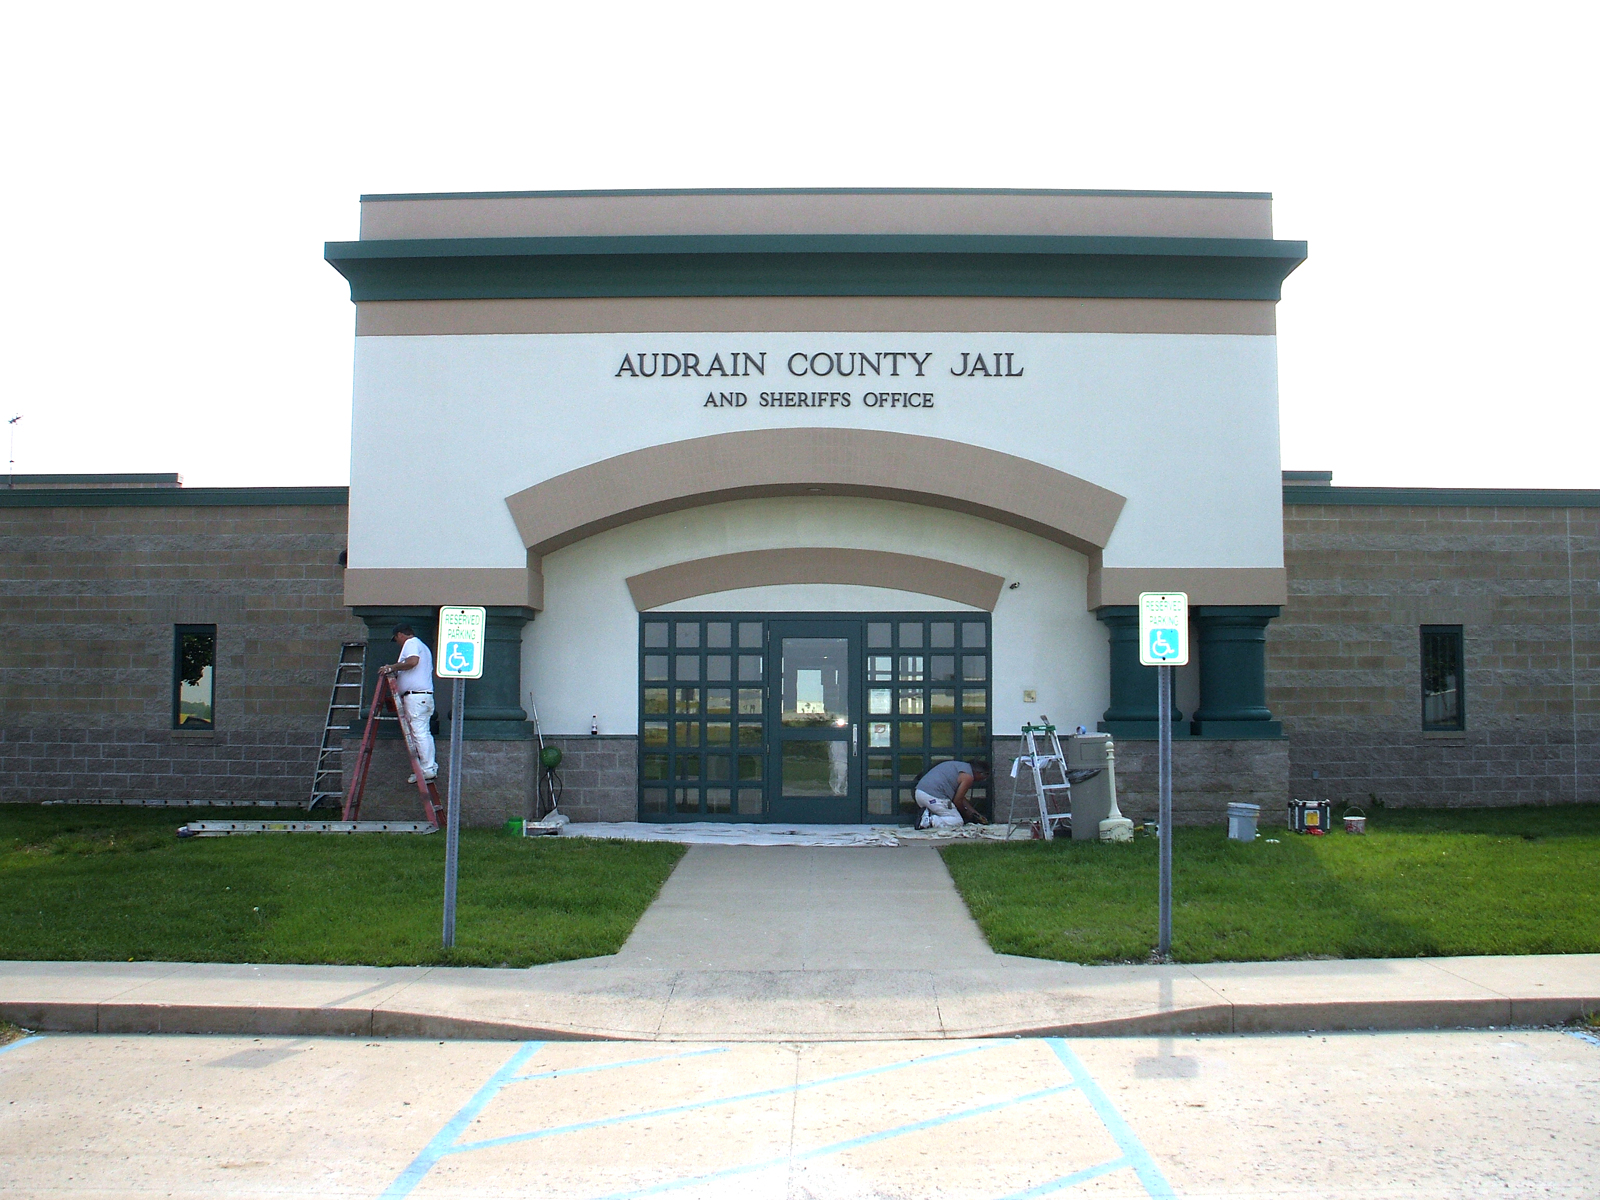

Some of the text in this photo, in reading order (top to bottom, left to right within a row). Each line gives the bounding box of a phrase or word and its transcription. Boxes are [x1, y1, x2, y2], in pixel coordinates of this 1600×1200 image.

[614, 351, 1025, 378] AUDRAIN COUNTY JAIL
[703, 391, 935, 408] AND SHERIFFS OFFICE
[1146, 600, 1182, 611] RESERVED
[445, 614, 480, 625] RESERVED
[1149, 615, 1179, 626] PARKING
[448, 628, 476, 640] PARKING
